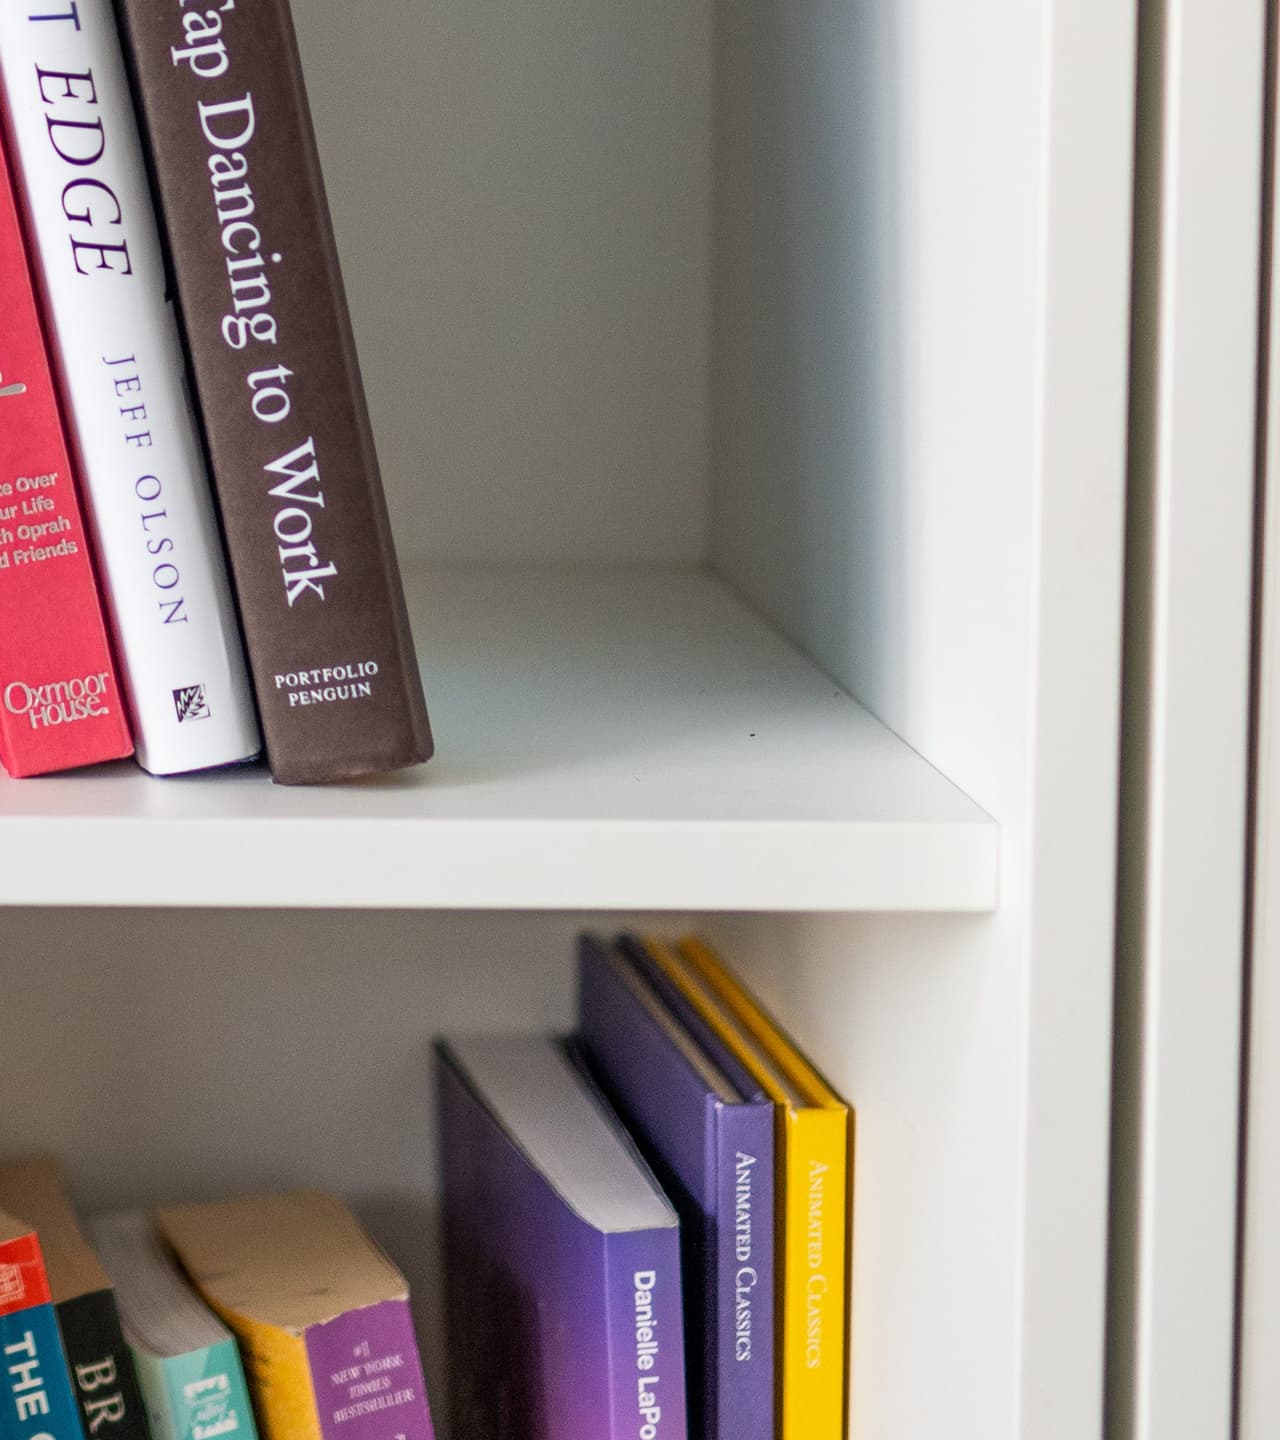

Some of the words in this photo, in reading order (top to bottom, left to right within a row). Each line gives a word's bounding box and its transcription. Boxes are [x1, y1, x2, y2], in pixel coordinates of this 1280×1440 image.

[35, 63, 132, 278] EDGE
[197, 92, 283, 349] Dancing
[248, 363, 295, 422] to
[16, 472, 58, 495] Over
[23, 495, 54, 515] Life
[102, 354, 153, 448] JEFF
[135, 474, 187, 626] OLSON
[13, 541, 77, 567] Friends
[19, 516, 71, 541] Oprah
[263, 436, 338, 607] Work
[4, 672, 109, 715] Oxmoor
[274, 661, 378, 689] PORTFOLIO
[288, 681, 371, 706] PENGUIN
[735, 1151, 756, 1262] ANIMATED
[634, 1270, 659, 1371] Danielle
[735, 1263, 757, 1362] CLASSICS
[4, 1331, 43, 1422] THE
